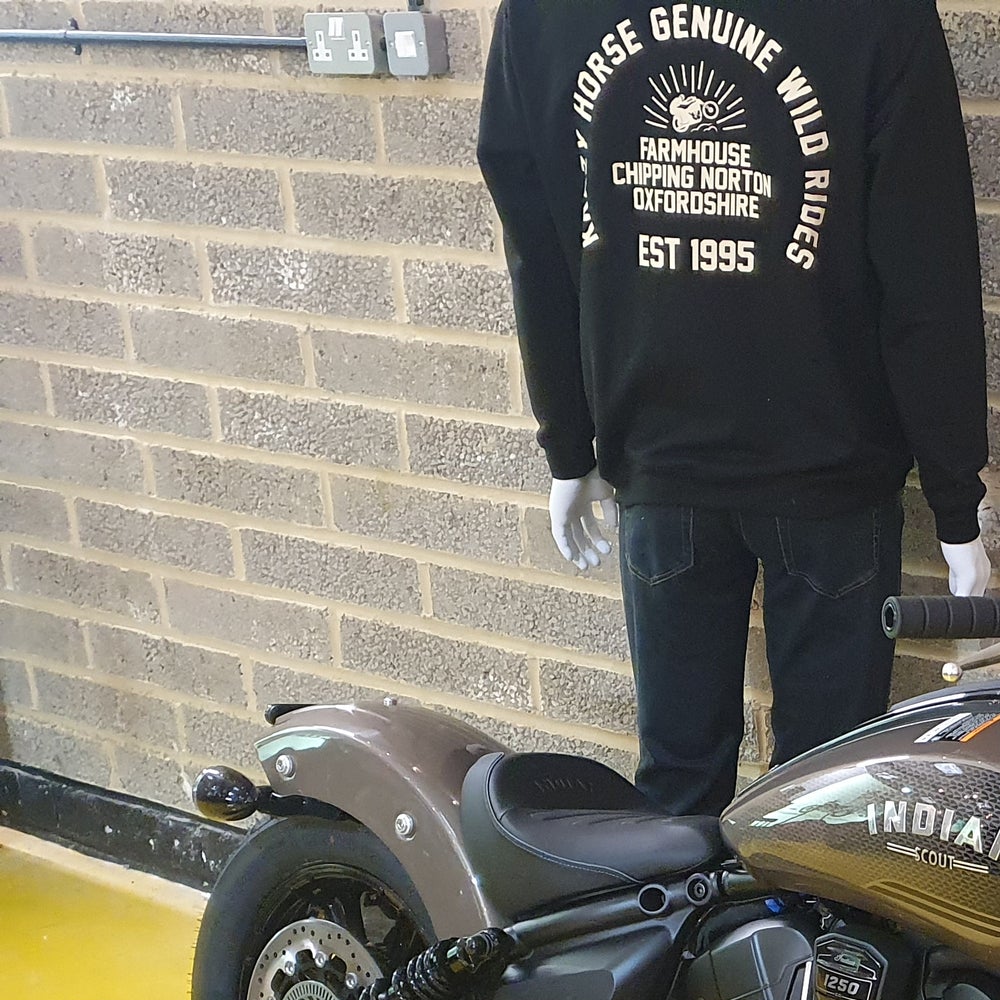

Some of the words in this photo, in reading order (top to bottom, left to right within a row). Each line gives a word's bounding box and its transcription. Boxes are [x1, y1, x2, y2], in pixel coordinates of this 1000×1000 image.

[649, 3, 783, 74] GENUINE
[573, 18, 644, 123] HORSE
[775, 65, 830, 158] WILD
[639, 136, 751, 167] FARMHOUSE
[612, 161, 694, 189] CHIPPING
[700, 166, 772, 198] NORTON
[633, 187, 760, 219] OXFORDSHIRE
[785, 168, 831, 271] RIDES
[638, 233, 681, 270] EST
[690, 238, 755, 273] 1995
[914, 846, 955, 870] SCOUT
[823, 974, 860, 995] 1250
